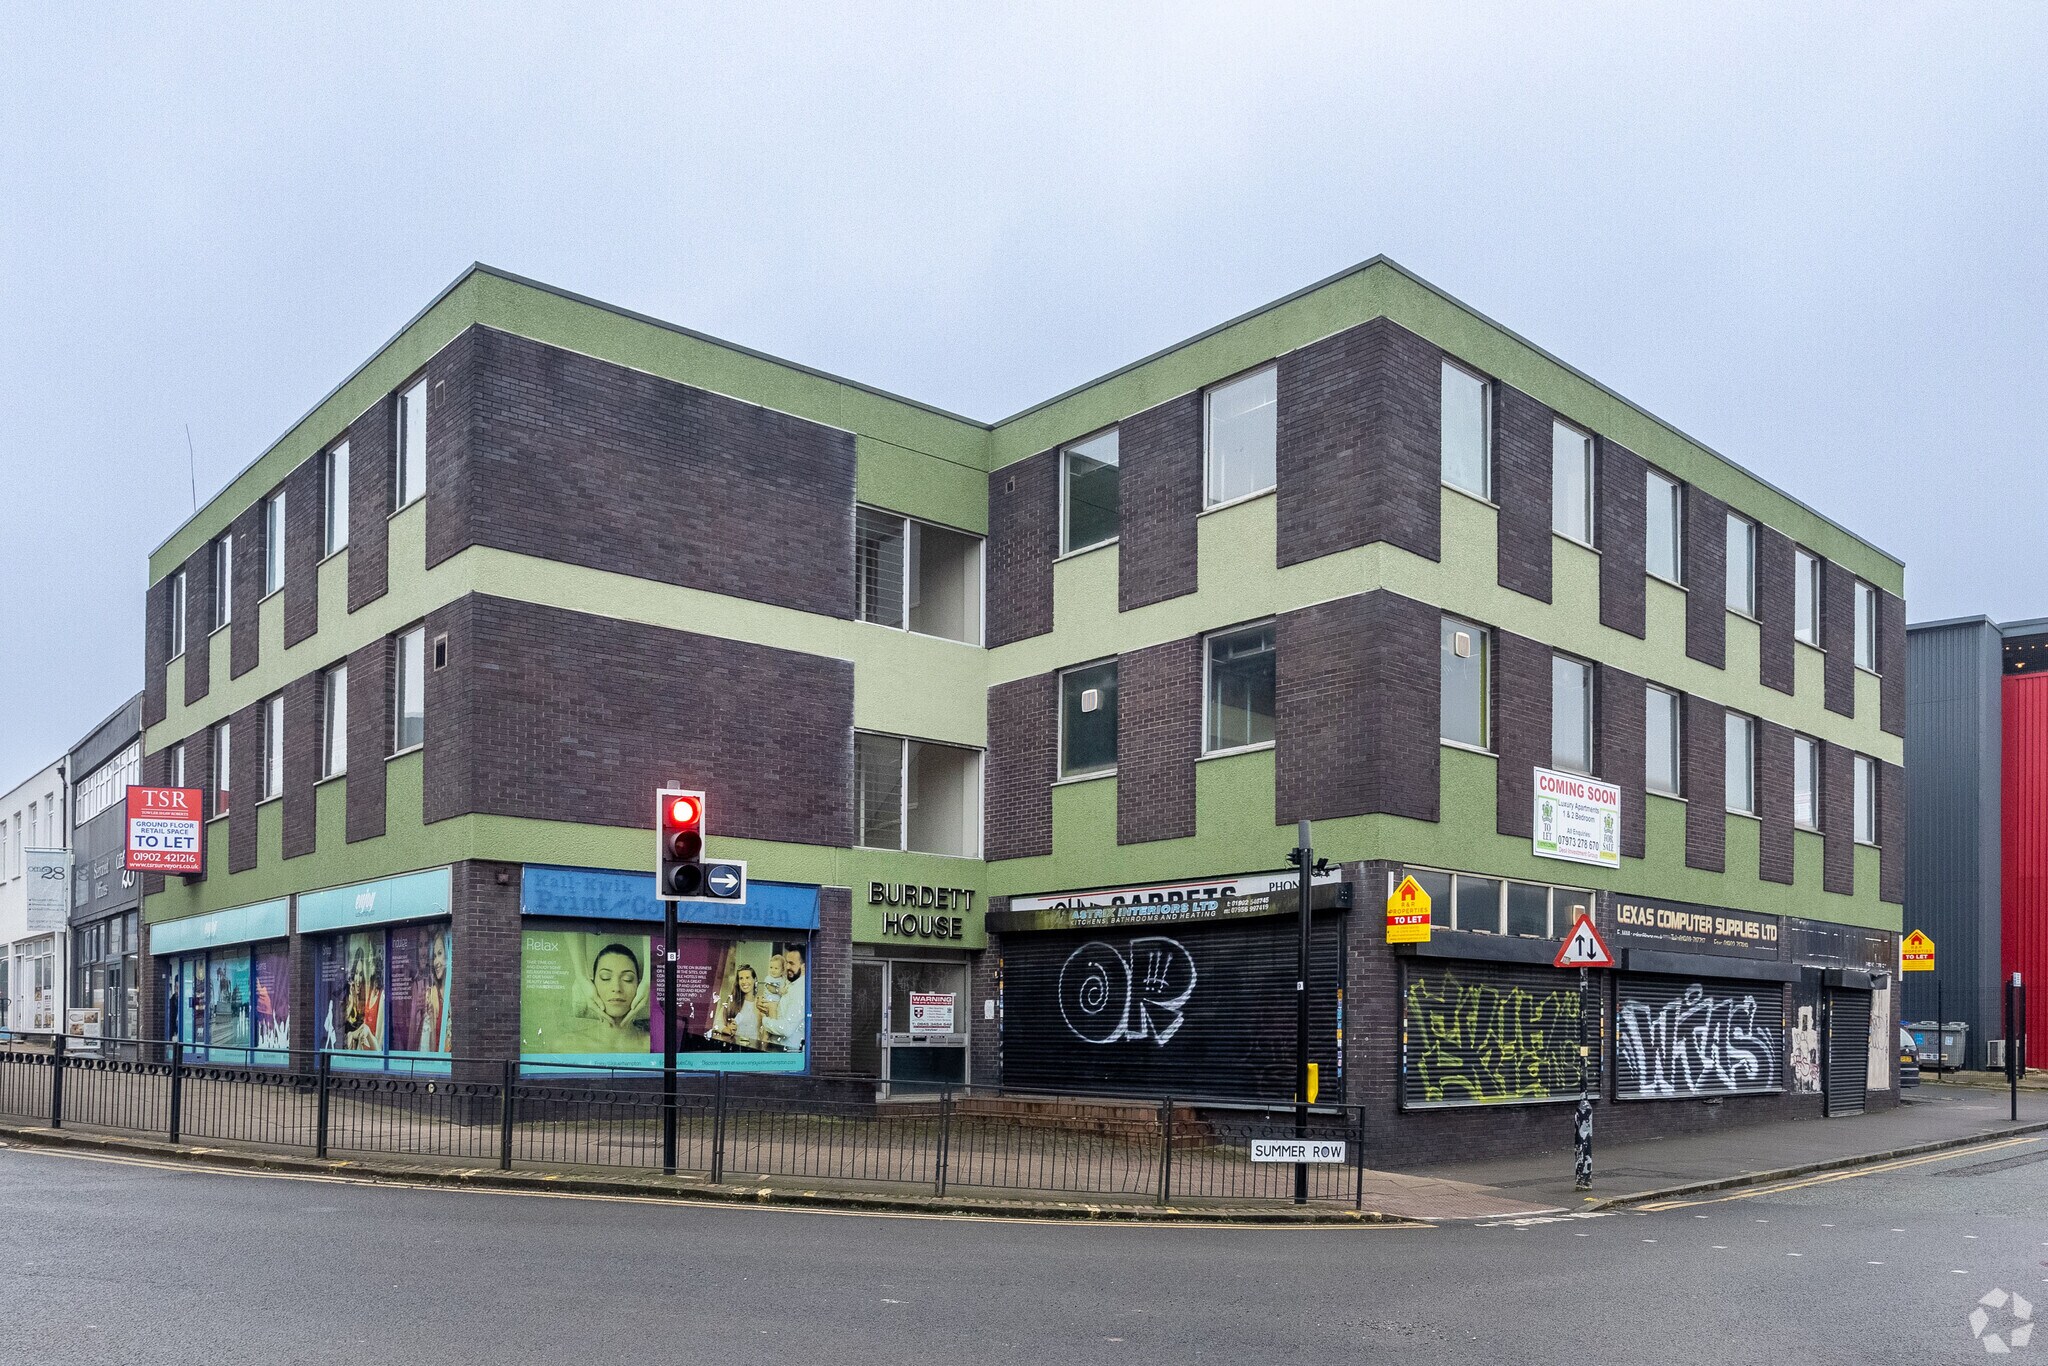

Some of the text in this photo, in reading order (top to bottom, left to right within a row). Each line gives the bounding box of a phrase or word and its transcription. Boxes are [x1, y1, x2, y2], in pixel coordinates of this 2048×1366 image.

[1540, 775, 1616, 805] COMING SOON
[141, 789, 189, 809] TSR
[134, 835, 195, 849] TO LET
[133, 852, 161, 861] 01902
[164, 853, 196, 863] 421216
[1269, 879, 1300, 892] PHON
[868, 881, 976, 912] BURDETT
[1117, 902, 1189, 917] INTERIORS
[1192, 900, 1219, 912] LTD
[1110, 914, 1159, 924] BATHROOMS
[1160, 912, 1178, 921] AND
[1179, 909, 1217, 919] HEATING
[1394, 915, 1423, 925] TO LET
[1617, 903, 1654, 927] LEXAS
[1657, 909, 1713, 934] COMPUTER
[1715, 917, 1760, 939] SUPPLIES
[1761, 923, 1778, 942] LTD
[883, 911, 963, 939] HOUSE
[526, 937, 559, 951] Relax
[1255, 1144, 1342, 1158] SUMMER ROW
